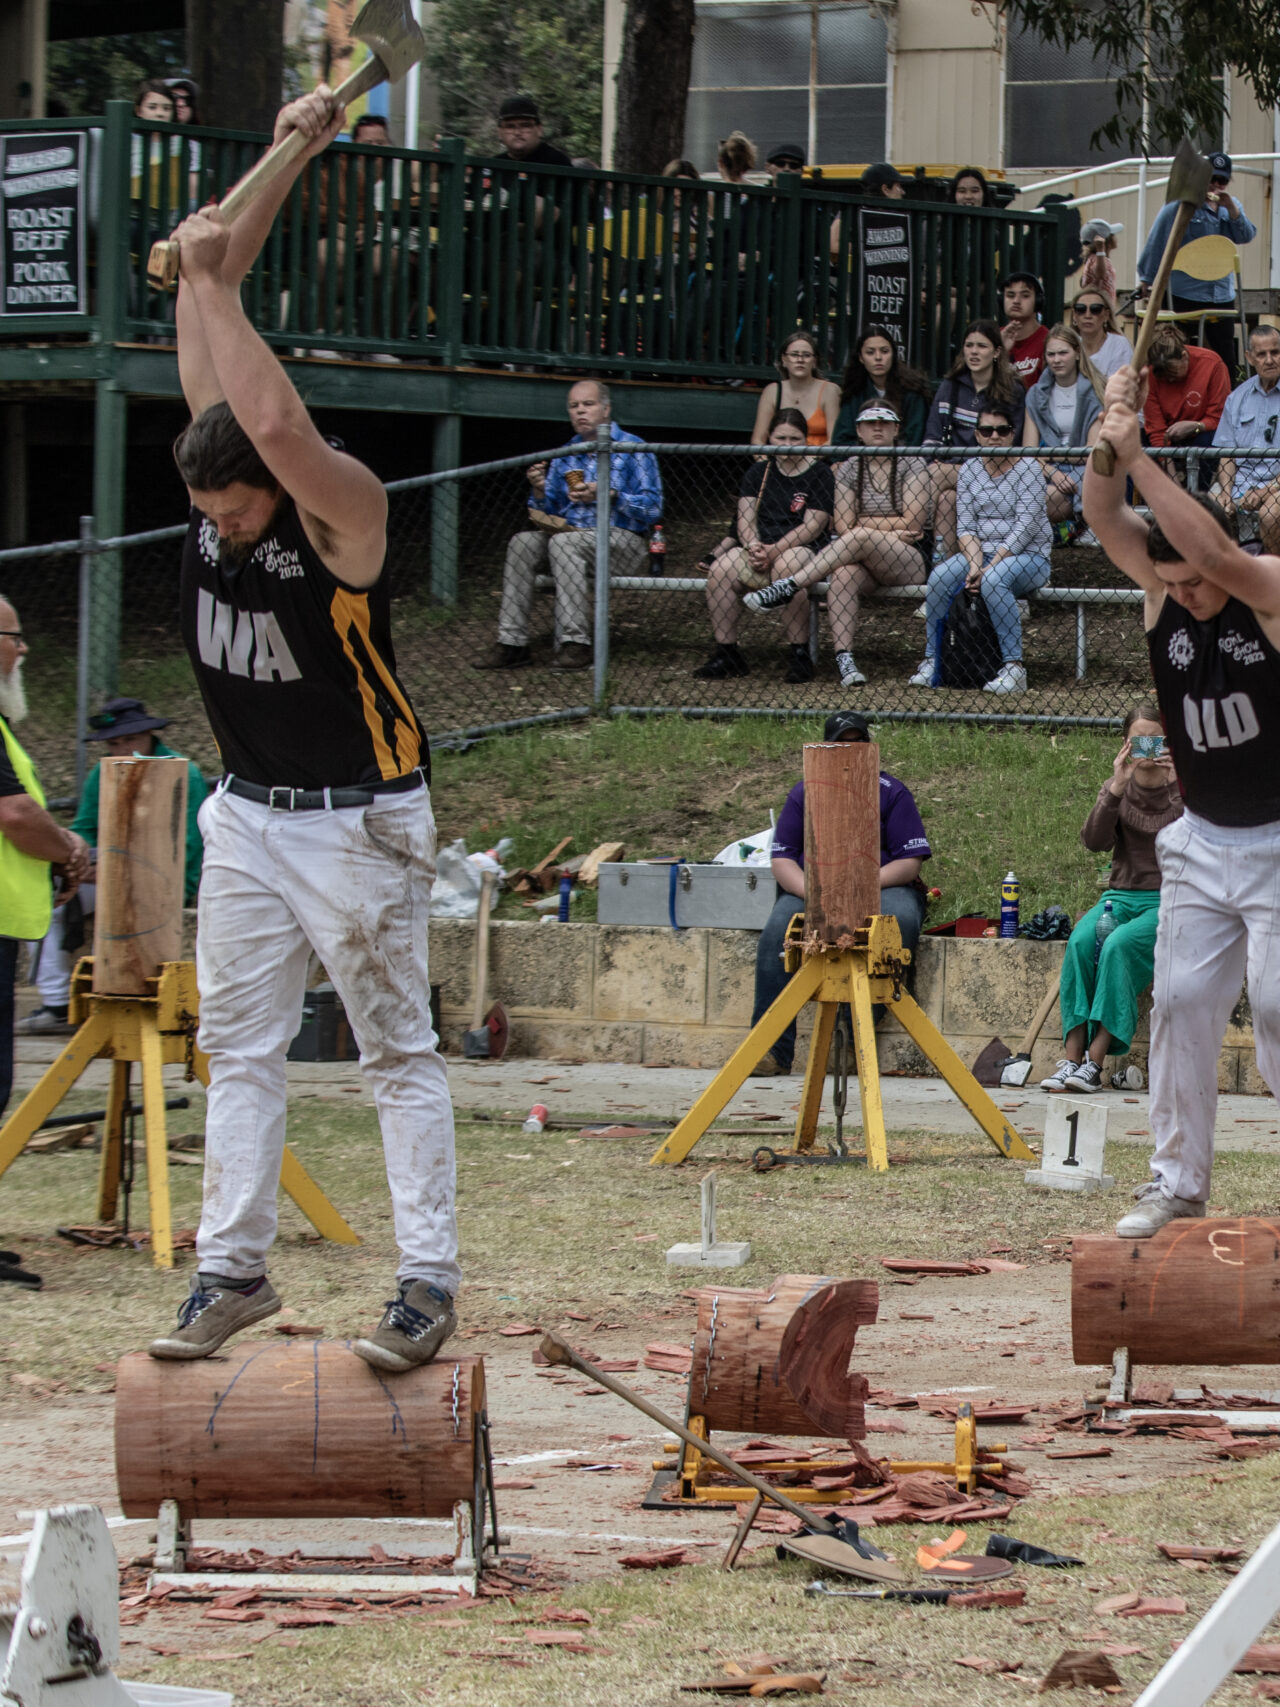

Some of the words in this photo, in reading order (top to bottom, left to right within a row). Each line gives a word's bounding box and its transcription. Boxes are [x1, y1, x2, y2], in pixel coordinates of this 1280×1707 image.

[7, 207, 75, 228] ROAST
[12, 231, 70, 251] BEEF
[867, 228, 905, 244] AWARD
[864, 247, 909, 265] WINNING
[13, 262, 71, 283] PORK
[6, 285, 77, 304] DINNER
[867, 275, 907, 295] ROAST
[870, 295, 903, 314] BEEF
[250, 537, 281, 564] OYAL
[265, 550, 299, 573] SHOW
[278, 564, 305, 580] 2023
[197, 587, 303, 682] WA
[1233, 640, 1260, 661] SHOW
[1243, 651, 1266, 666] 2023
[1062, 1110, 1080, 1167] 1
